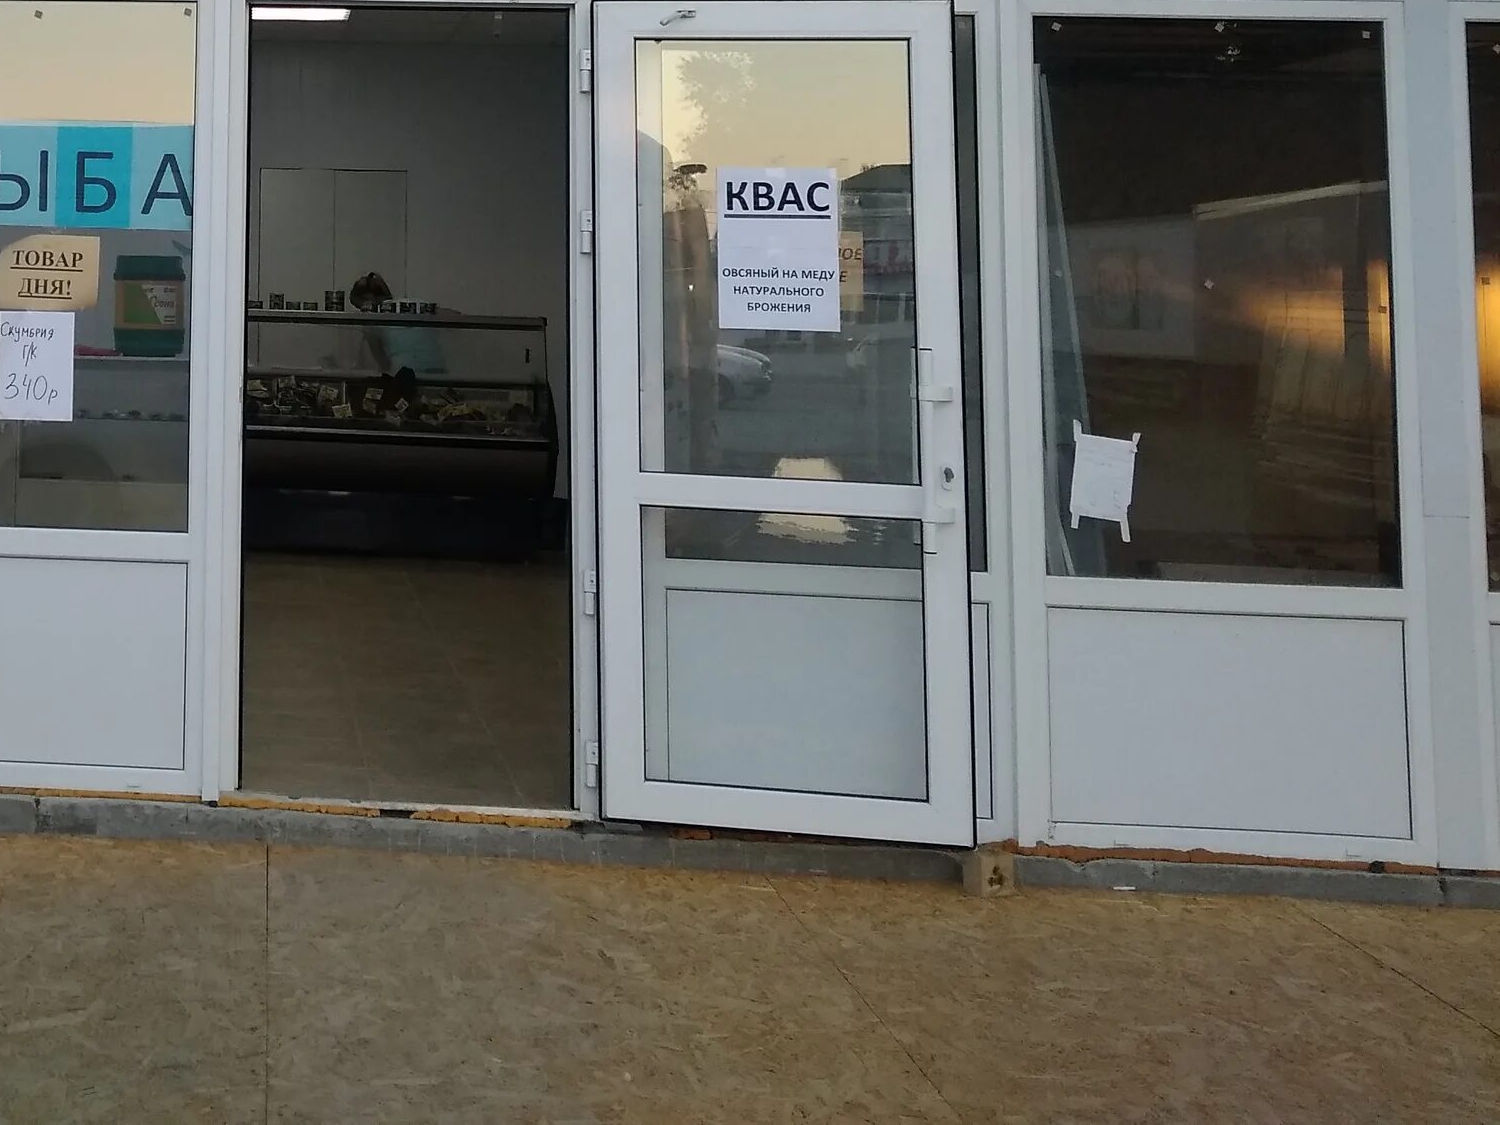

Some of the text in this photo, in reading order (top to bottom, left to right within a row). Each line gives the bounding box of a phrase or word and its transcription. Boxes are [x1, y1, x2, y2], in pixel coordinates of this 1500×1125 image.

[726, 181, 830, 212] КВАС
[12, 250, 83, 268] ТОВАР
[722, 267, 779, 280] ОВСЯНЫЙ
[782, 269, 798, 280] НА
[802, 270, 835, 282] МЕДУ
[19, 278, 72, 297] ДНЯ!
[733, 286, 825, 297] НАТУРАЛЬНОГО
[747, 302, 811, 313] БРОЖЕНИЯ
